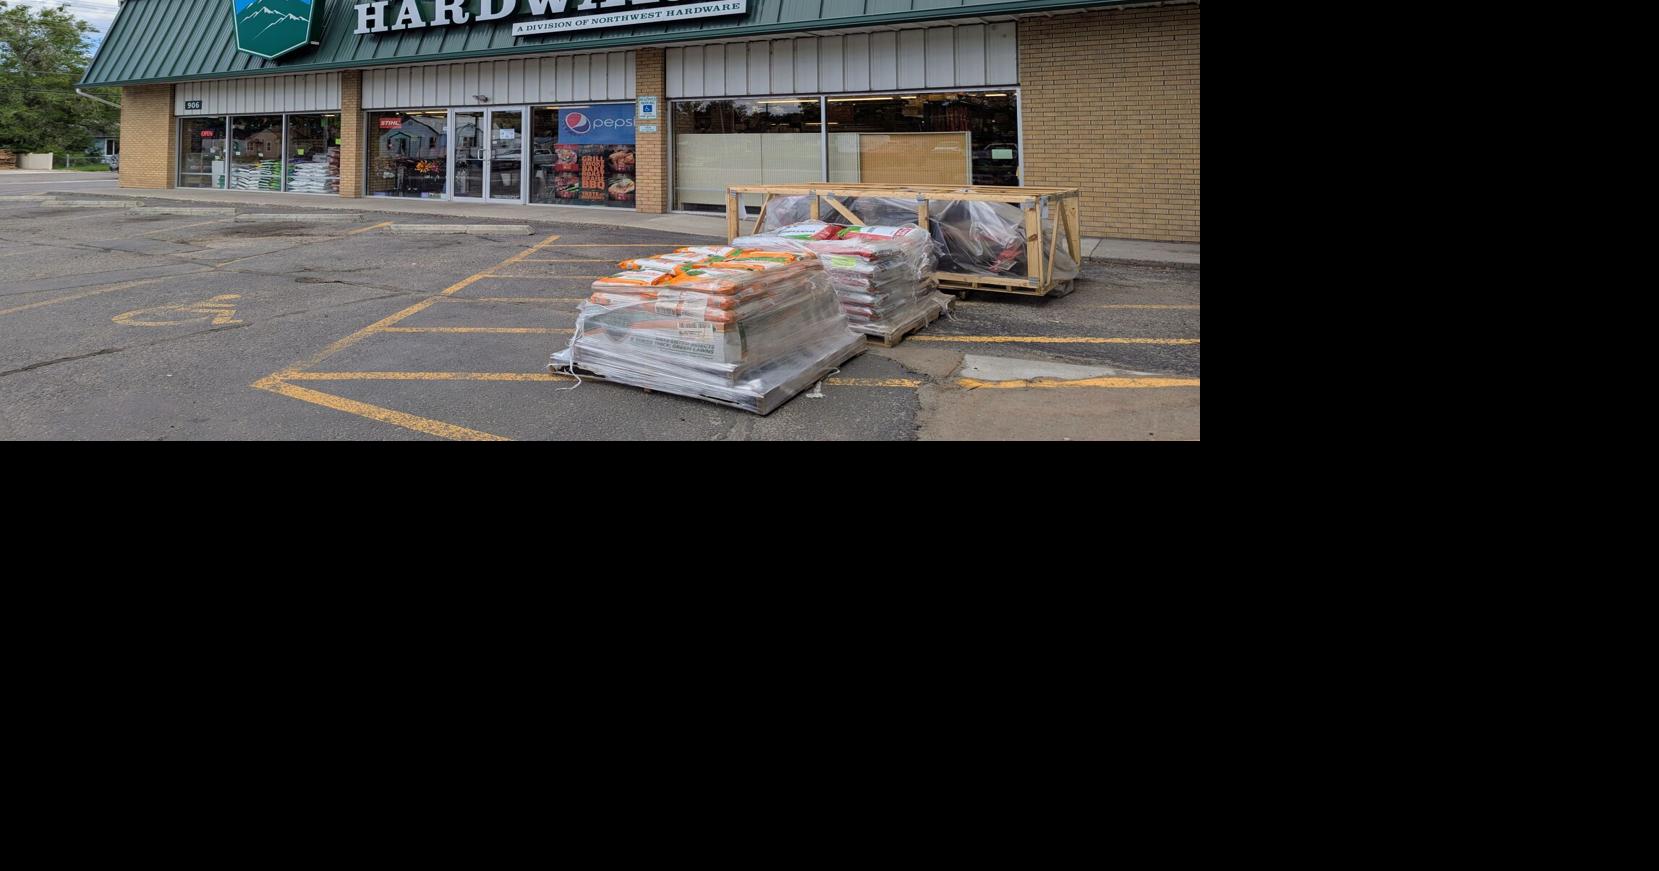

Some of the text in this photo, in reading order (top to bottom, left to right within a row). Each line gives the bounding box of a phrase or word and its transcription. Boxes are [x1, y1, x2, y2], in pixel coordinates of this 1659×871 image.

[354, 0, 684, 35] HARD
[526, 21, 572, 32] DIVISION
[575, 18, 590, 26] OF
[591, 11, 663, 25] NORTHWEST
[666, 2, 741, 17] HARDWARE
[187, 101, 200, 109] 906
[582, 180, 605, 189] BBQ
